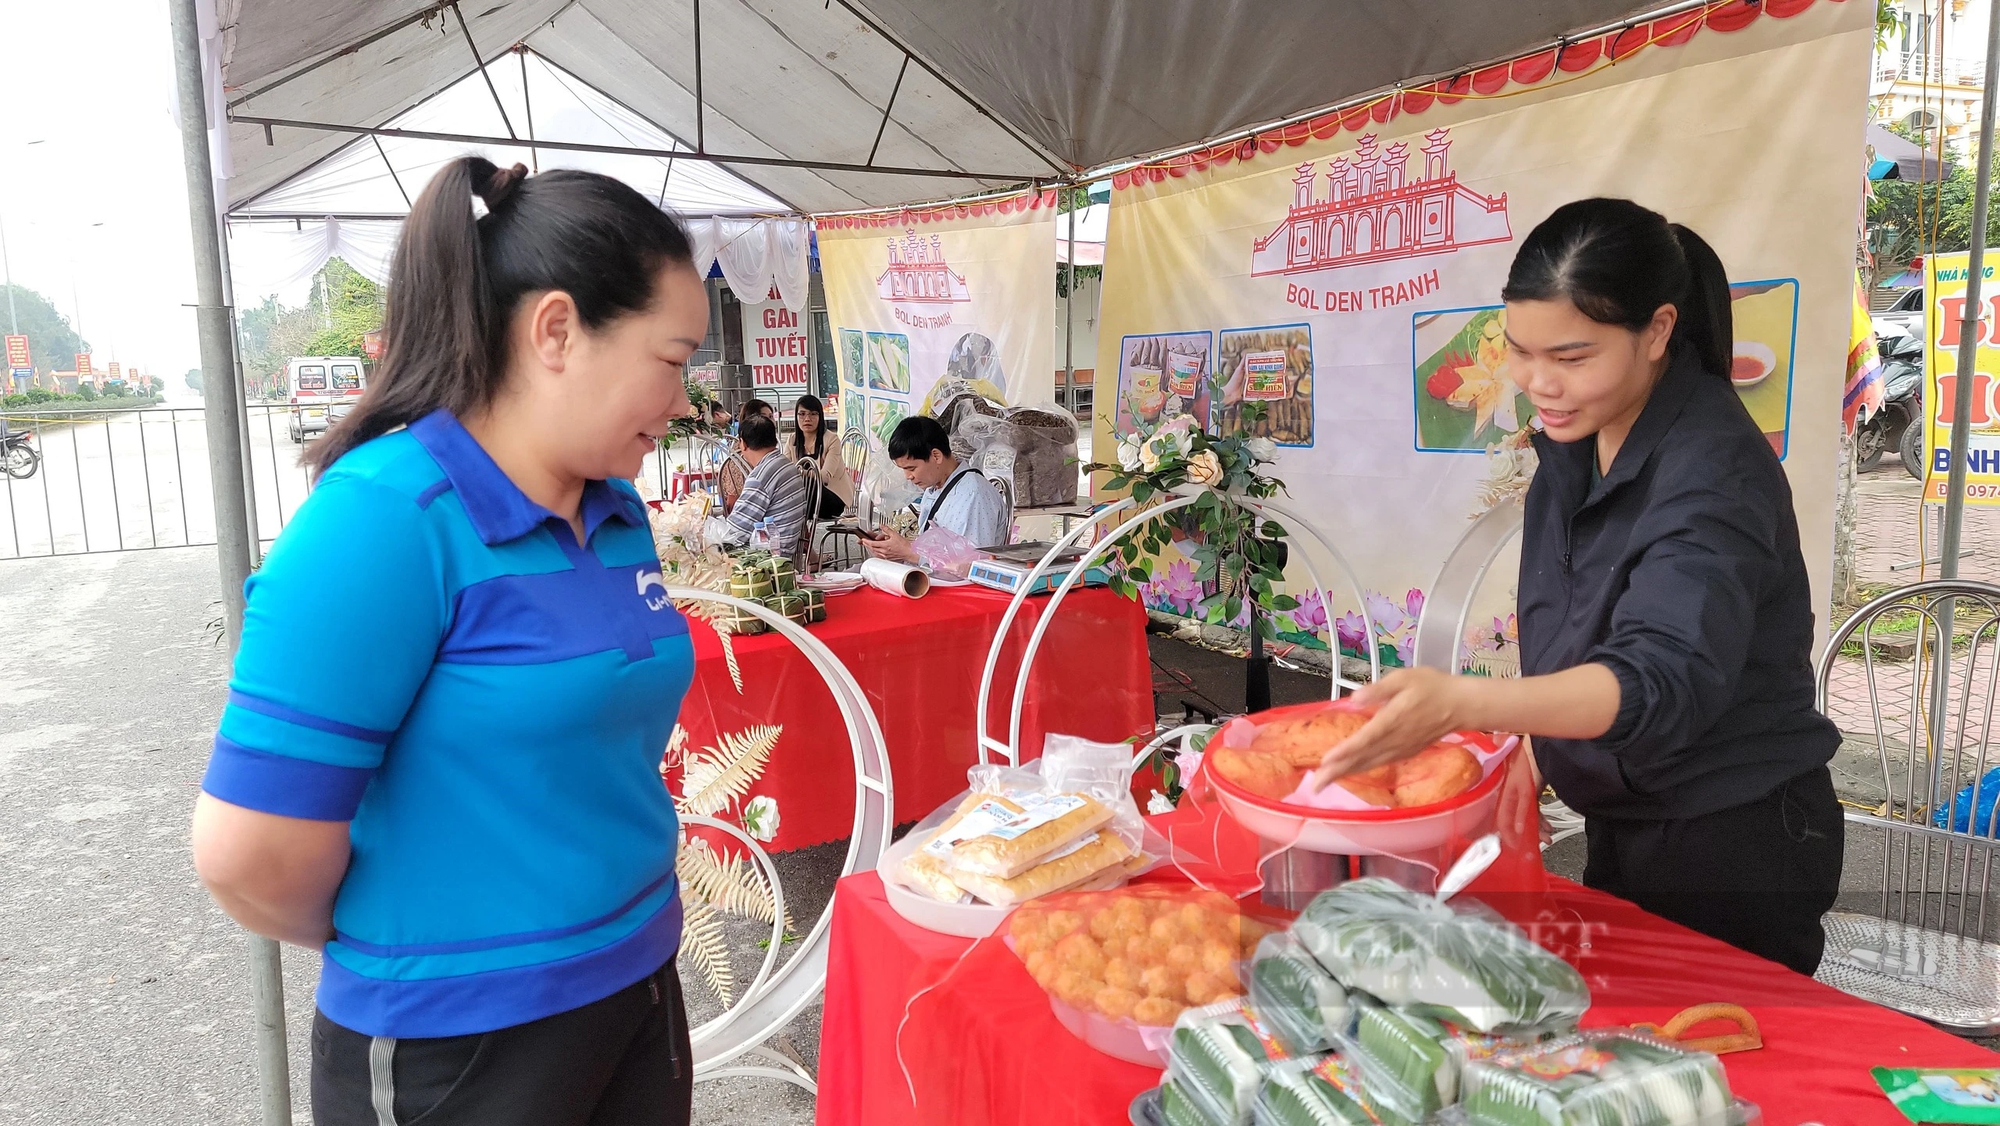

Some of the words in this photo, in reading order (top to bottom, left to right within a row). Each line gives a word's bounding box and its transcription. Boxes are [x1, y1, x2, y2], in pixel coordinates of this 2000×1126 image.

[1960, 266, 1994, 280] HNG
[1286, 283, 1319, 311] BQL
[1325, 290, 1363, 312] DEN
[1368, 268, 1440, 310] TRANH
[762, 308, 798, 329] GAI
[894, 307, 911, 325] BQL
[912, 314, 928, 329] DEN
[928, 311, 953, 330] TRANH
[755, 331, 807, 358] TUYẾT
[753, 363, 807, 385] TRUNG
[1934, 448, 2000, 474] BNH
